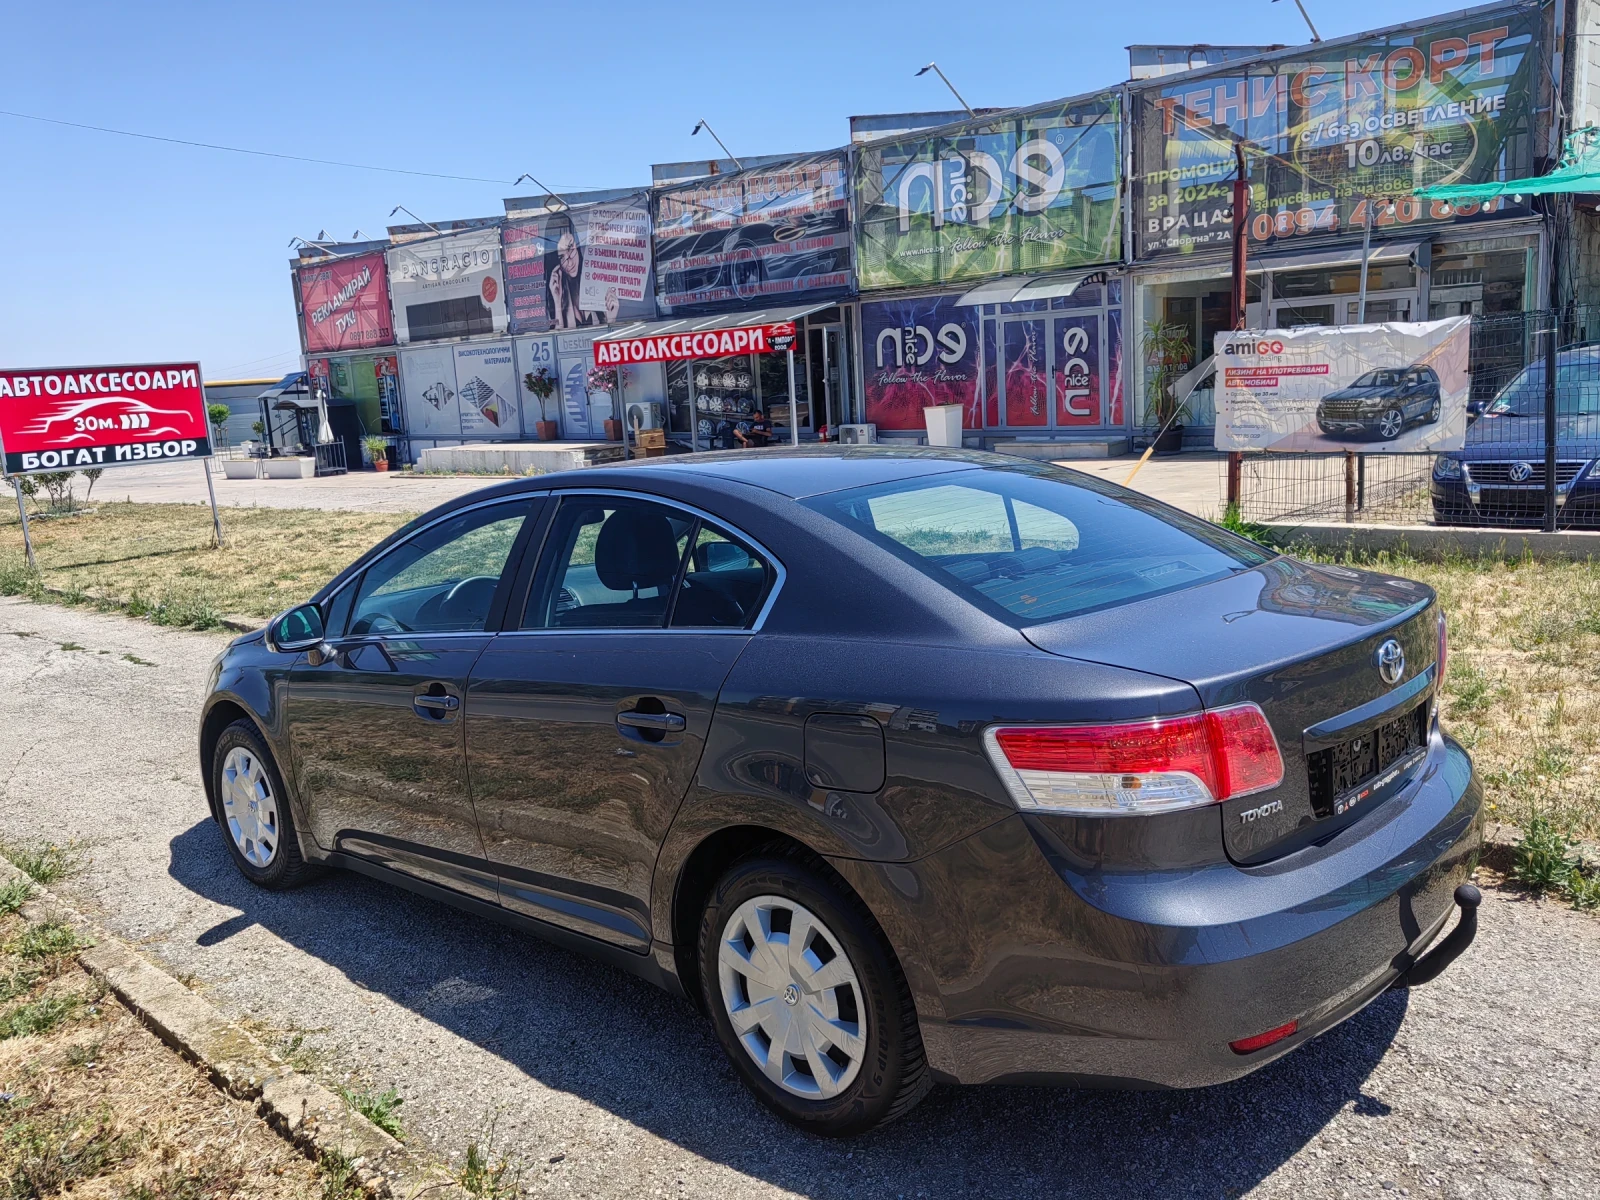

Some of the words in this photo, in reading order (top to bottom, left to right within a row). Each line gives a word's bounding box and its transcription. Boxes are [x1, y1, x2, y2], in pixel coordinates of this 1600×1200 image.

[1154, 66, 1326, 134] ТЕНИС
[1344, 26, 1509, 100] КОРТ
[1365, 94, 1506, 131] ОСВЕТЛЕНИЕ
[1147, 158, 1238, 185] ПРОМОЦИ
[658, 159, 841, 221] АВТОАКСЕСОАРИ
[950, 156, 973, 224] nice
[1253, 188, 1330, 212] записване
[1335, 184, 1353, 198] на
[1357, 176, 1413, 194] часове
[1148, 194, 1168, 212] за
[1148, 209, 1224, 233] ВРАЦА
[1252, 204, 1341, 240] 0894
[1349, 195, 1421, 226] 420
[595, 236, 619, 246] ПЕЧАТНА
[620, 238, 646, 249] РЕКЛАМА
[900, 246, 944, 257] www.nice.bg
[950, 239, 988, 254] Follow
[991, 231, 1014, 247] the
[1020, 226, 1066, 244] Flavor
[402, 249, 489, 279] PANCRACIO
[590, 260, 618, 271] РЕКЛАМНИ
[618, 263, 646, 274] СУВЕНИРИ
[618, 250, 644, 261] РЕКЛАМА
[508, 260, 545, 279] РЕКЛАМА
[591, 272, 619, 284] ФИРМЕНИ
[619, 275, 641, 286] ПЕЧАТИ
[311, 264, 371, 326] РЕКЛАМИРАЙ
[422, 281, 441, 289] ARTISAN
[443, 277, 470, 287] CHOCOLATE
[618, 287, 642, 299] ТЕНИСКИ
[335, 309, 356, 334] ТУК!
[531, 341, 551, 362] 25
[598, 328, 764, 364] АВТОАКСЕСОАРИ
[905, 326, 918, 365] nice
[484, 356, 511, 365] МАТЕРИАЛИ
[1226, 368, 1256, 376] ЛИЗИНГ
[1267, 365, 1327, 375] УПОТРЕБЯВАНИ
[0, 369, 197, 398] АВТОАКСЕСОАРИ
[877, 371, 908, 386] Follow
[912, 371, 930, 383] the
[932, 369, 967, 384] Flavor
[1064, 373, 1090, 386] nice
[1227, 378, 1277, 386] АВТОМОБИЛИ
[73, 416, 119, 432] 30м.
[22, 447, 106, 470] БОГАТ
[115, 439, 197, 461] ИЗБОР
[1240, 800, 1283, 824] TOYOTA
